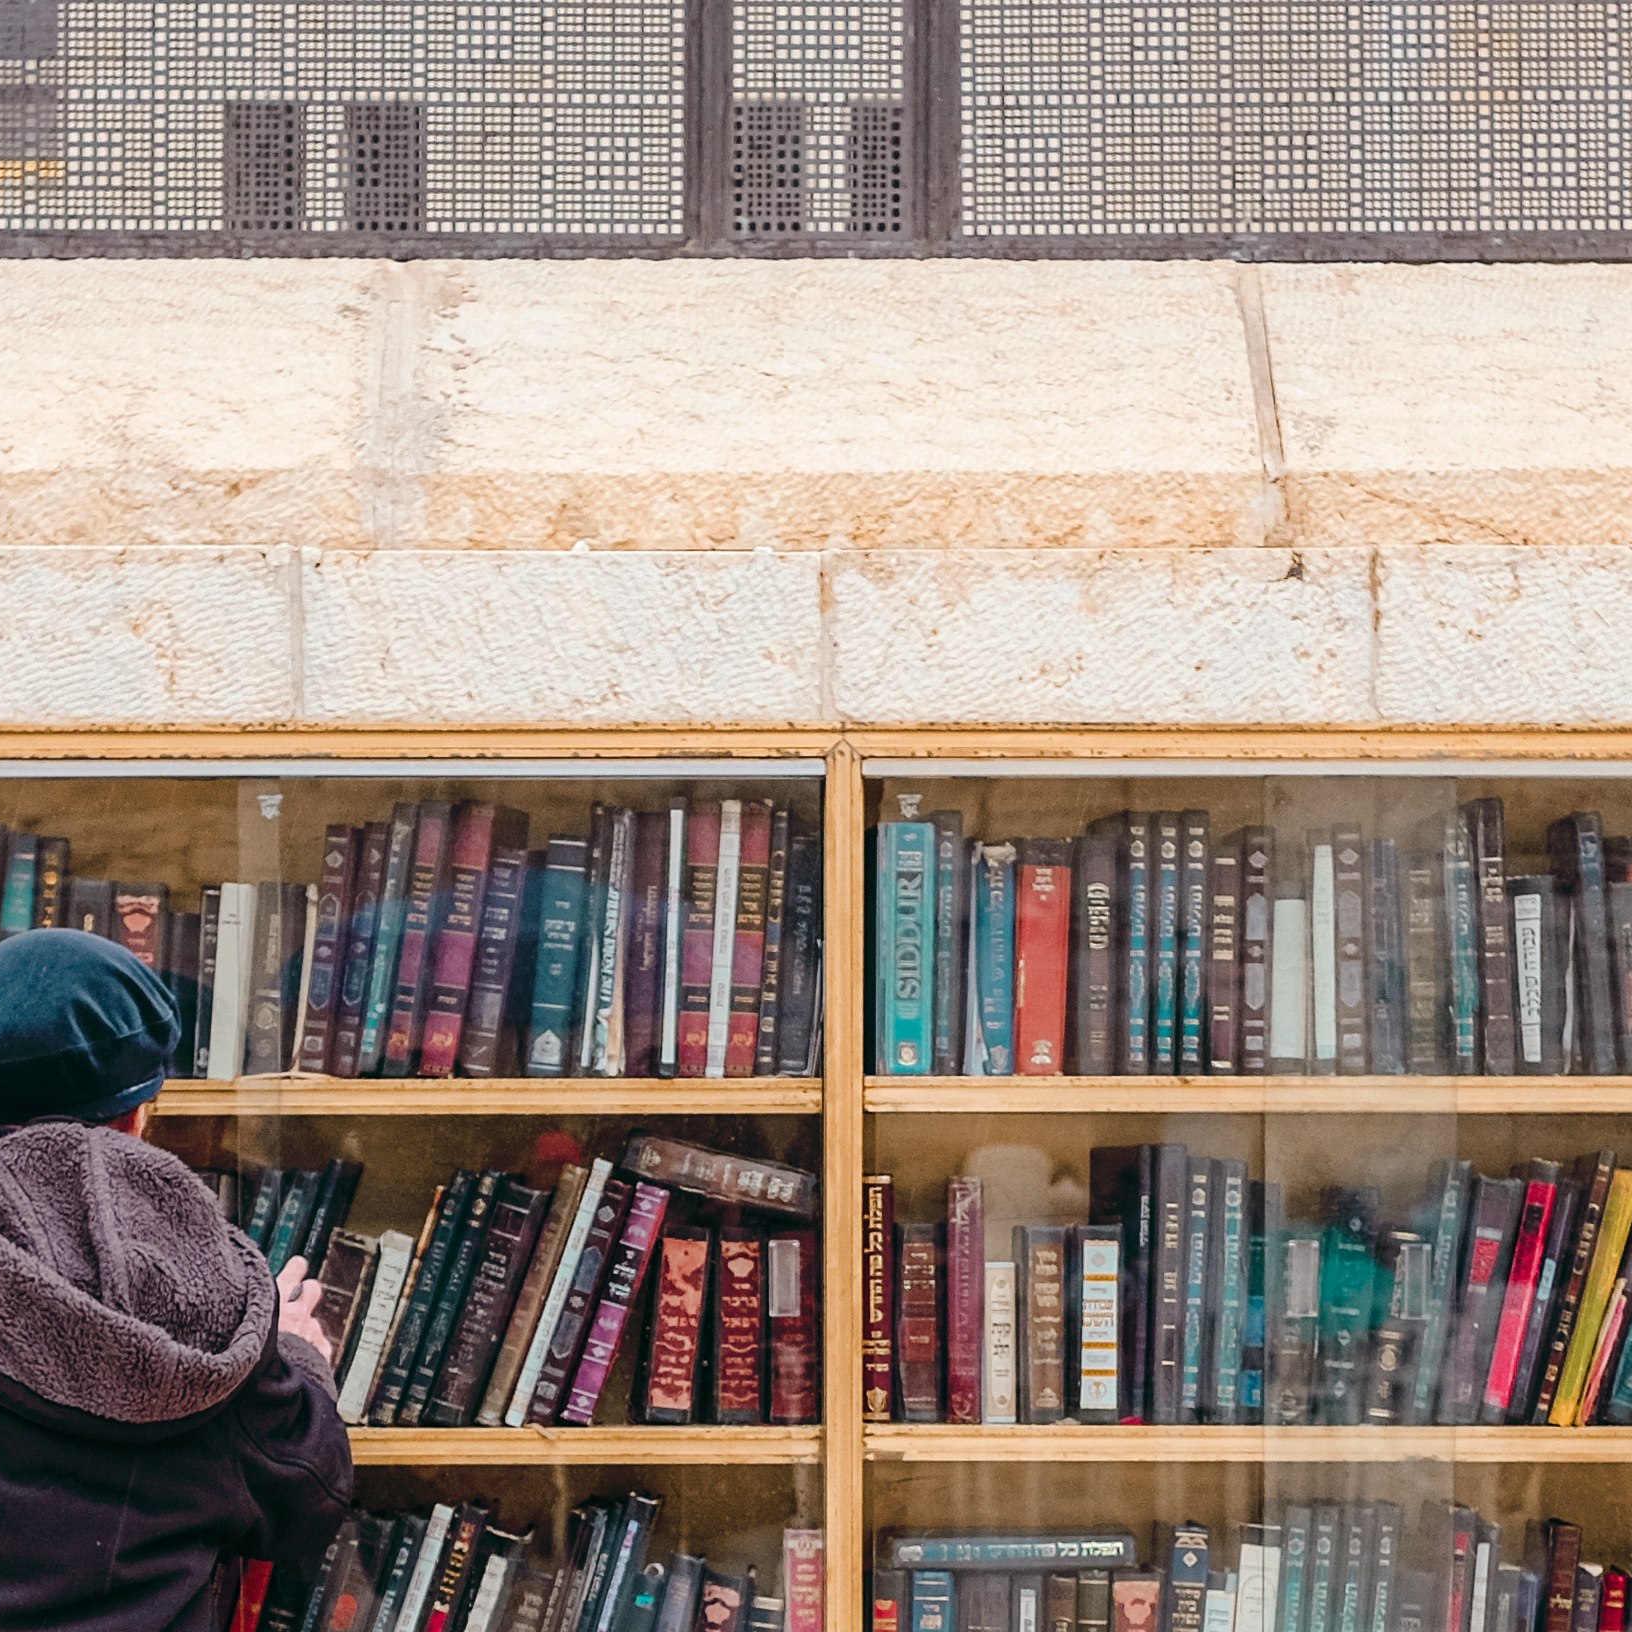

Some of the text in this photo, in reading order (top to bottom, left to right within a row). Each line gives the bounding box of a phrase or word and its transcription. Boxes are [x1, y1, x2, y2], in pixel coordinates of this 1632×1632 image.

[896, 873, 922, 999] SIDDUR
[862, 1186, 882, 1323] תפלת כל פה החדש
[1056, 1540, 1079, 1556] כל
